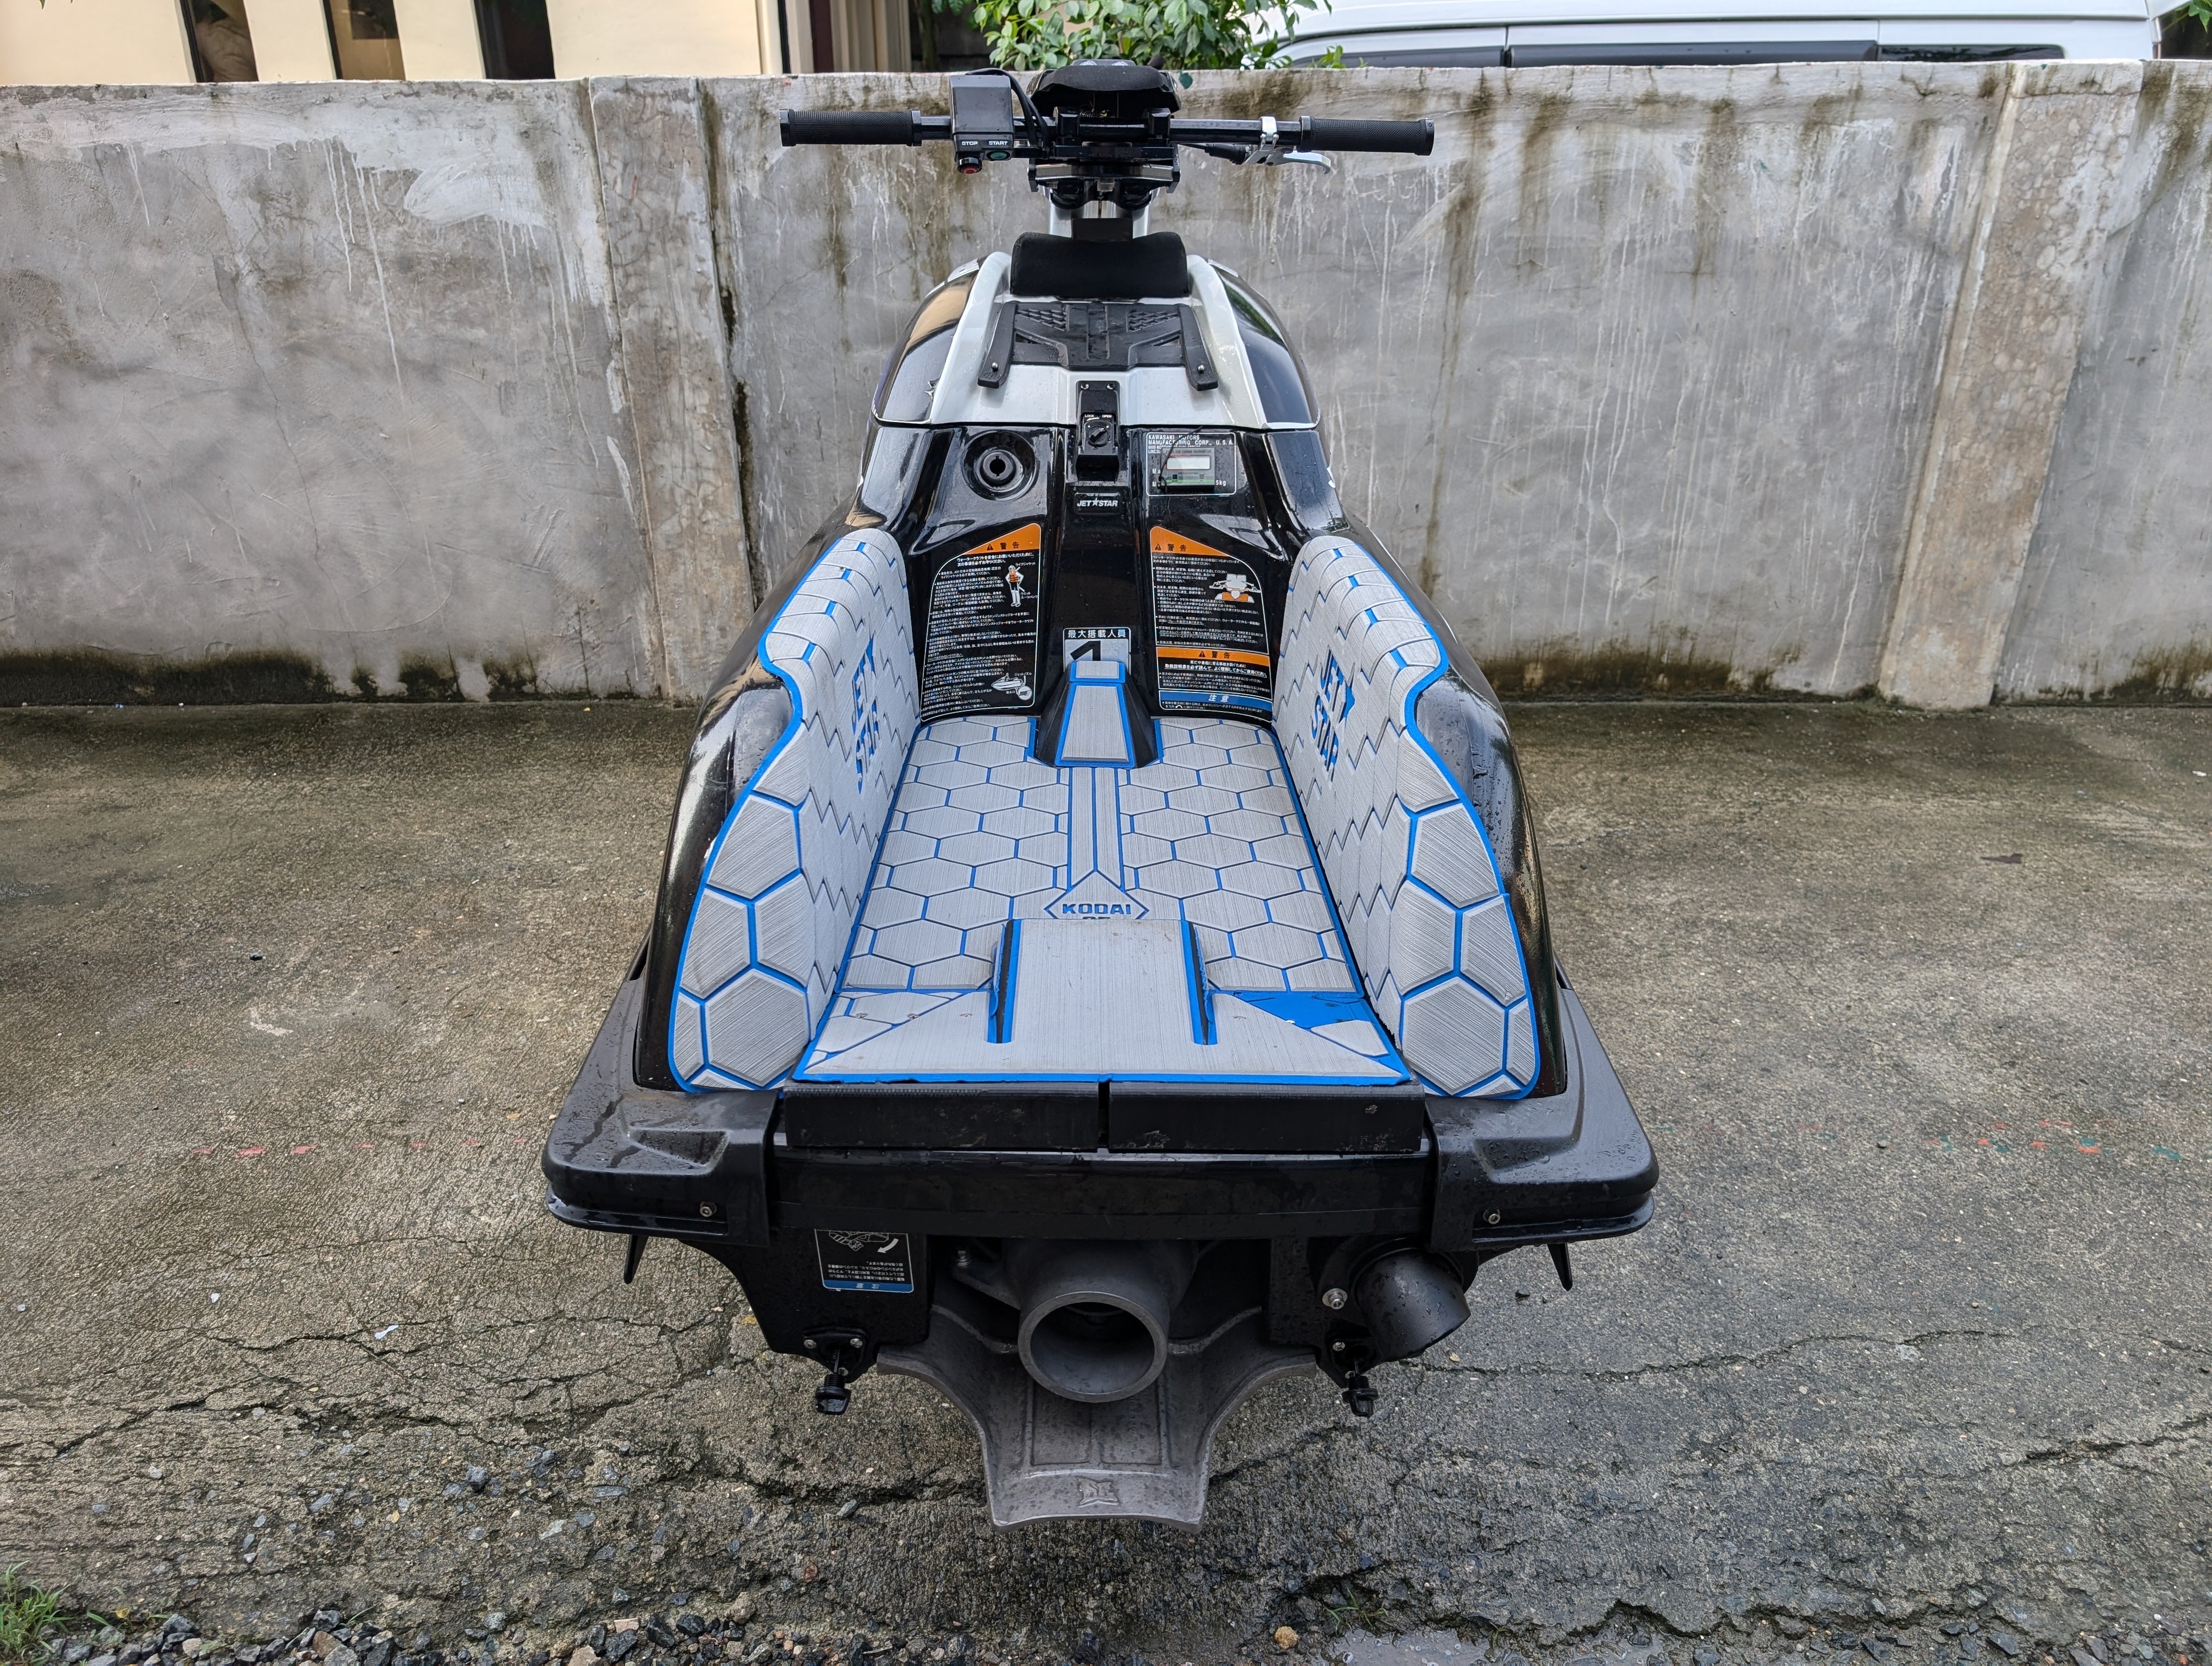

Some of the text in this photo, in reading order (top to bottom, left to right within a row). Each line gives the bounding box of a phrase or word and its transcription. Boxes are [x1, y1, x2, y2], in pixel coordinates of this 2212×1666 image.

[1167, 544, 1187, 553] 警告
[1068, 629, 1126, 638] 最大搭載人員
[1211, 651, 1231, 659] 警告
[1062, 903, 1131, 915] KODAI
